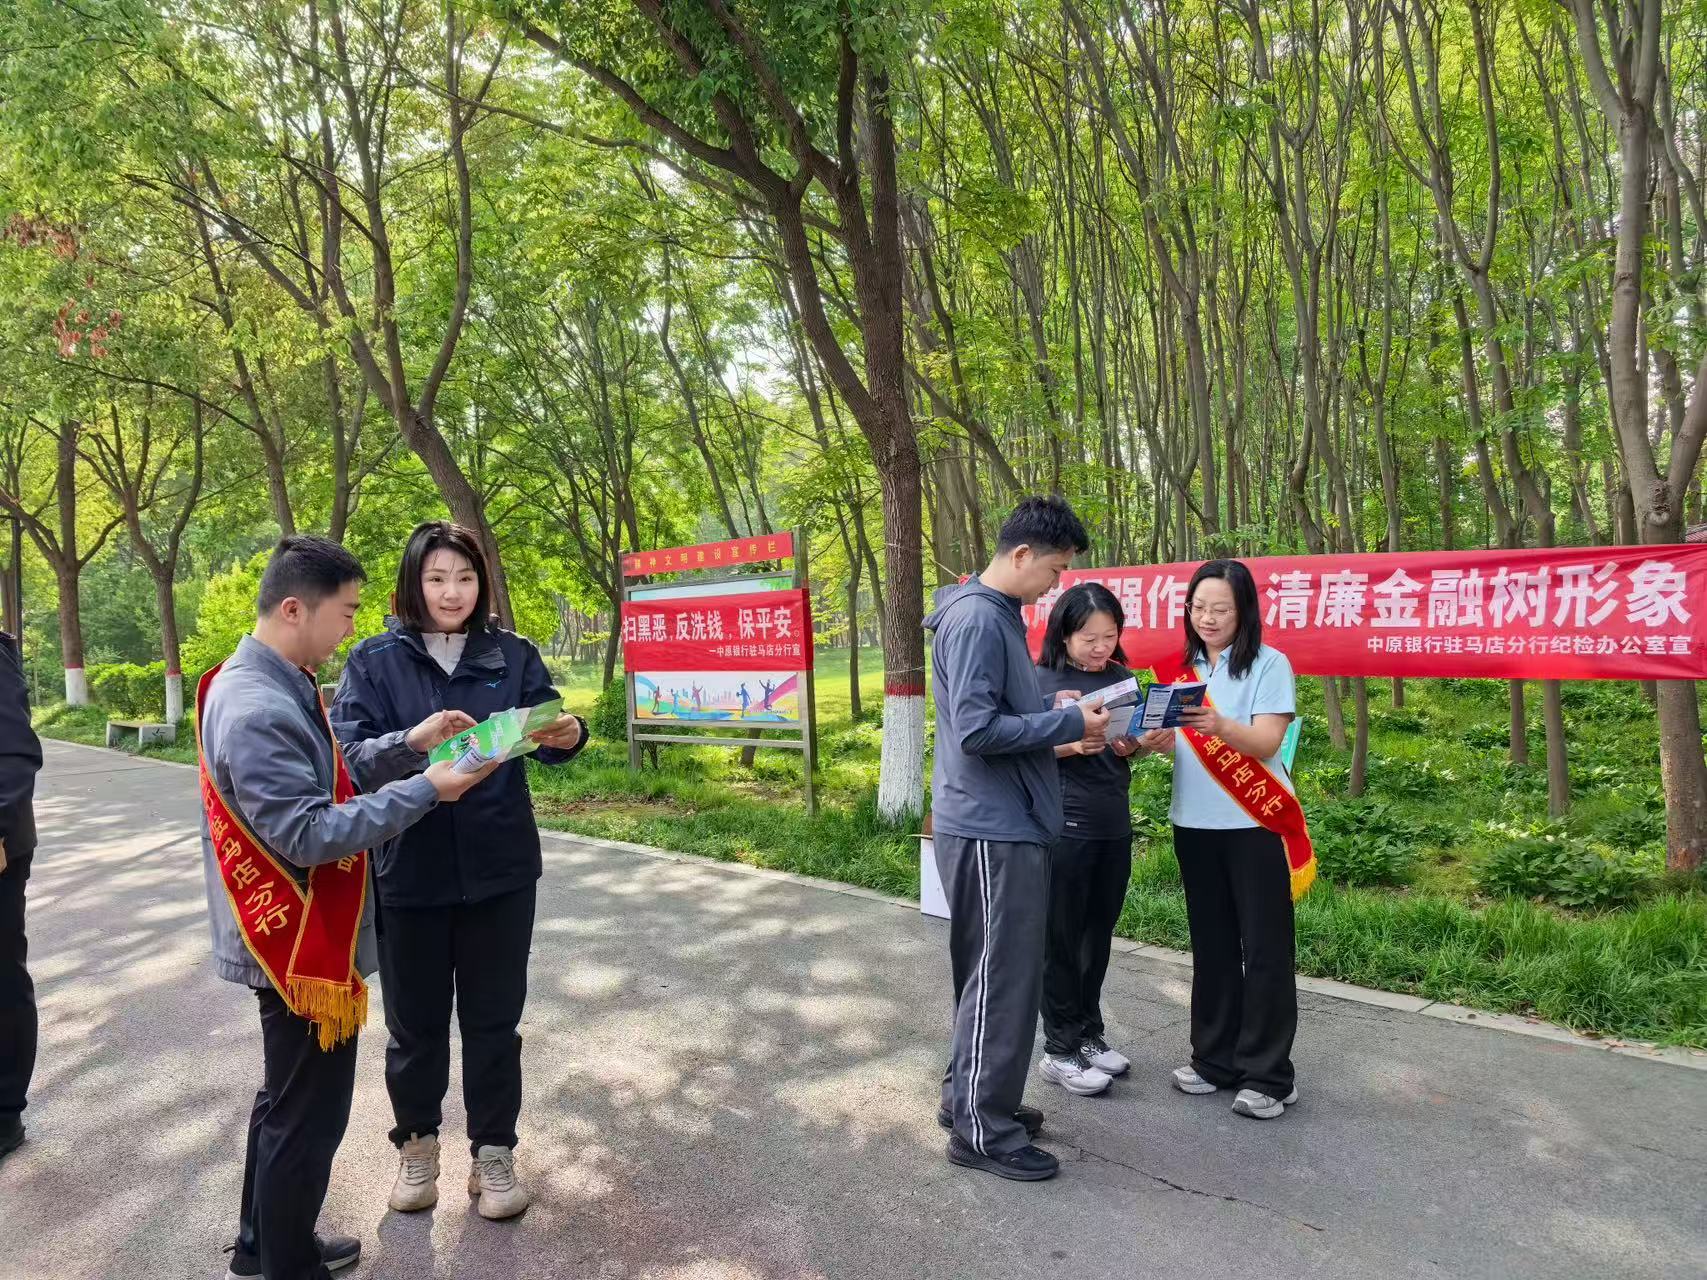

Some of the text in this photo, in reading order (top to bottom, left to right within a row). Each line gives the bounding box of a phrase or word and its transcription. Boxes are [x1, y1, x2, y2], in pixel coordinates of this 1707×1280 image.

[1264, 559, 1693, 630] 清廉金融树形象
[1367, 635, 1693, 656] 中原银行驻马店分行纪检办公室宣
